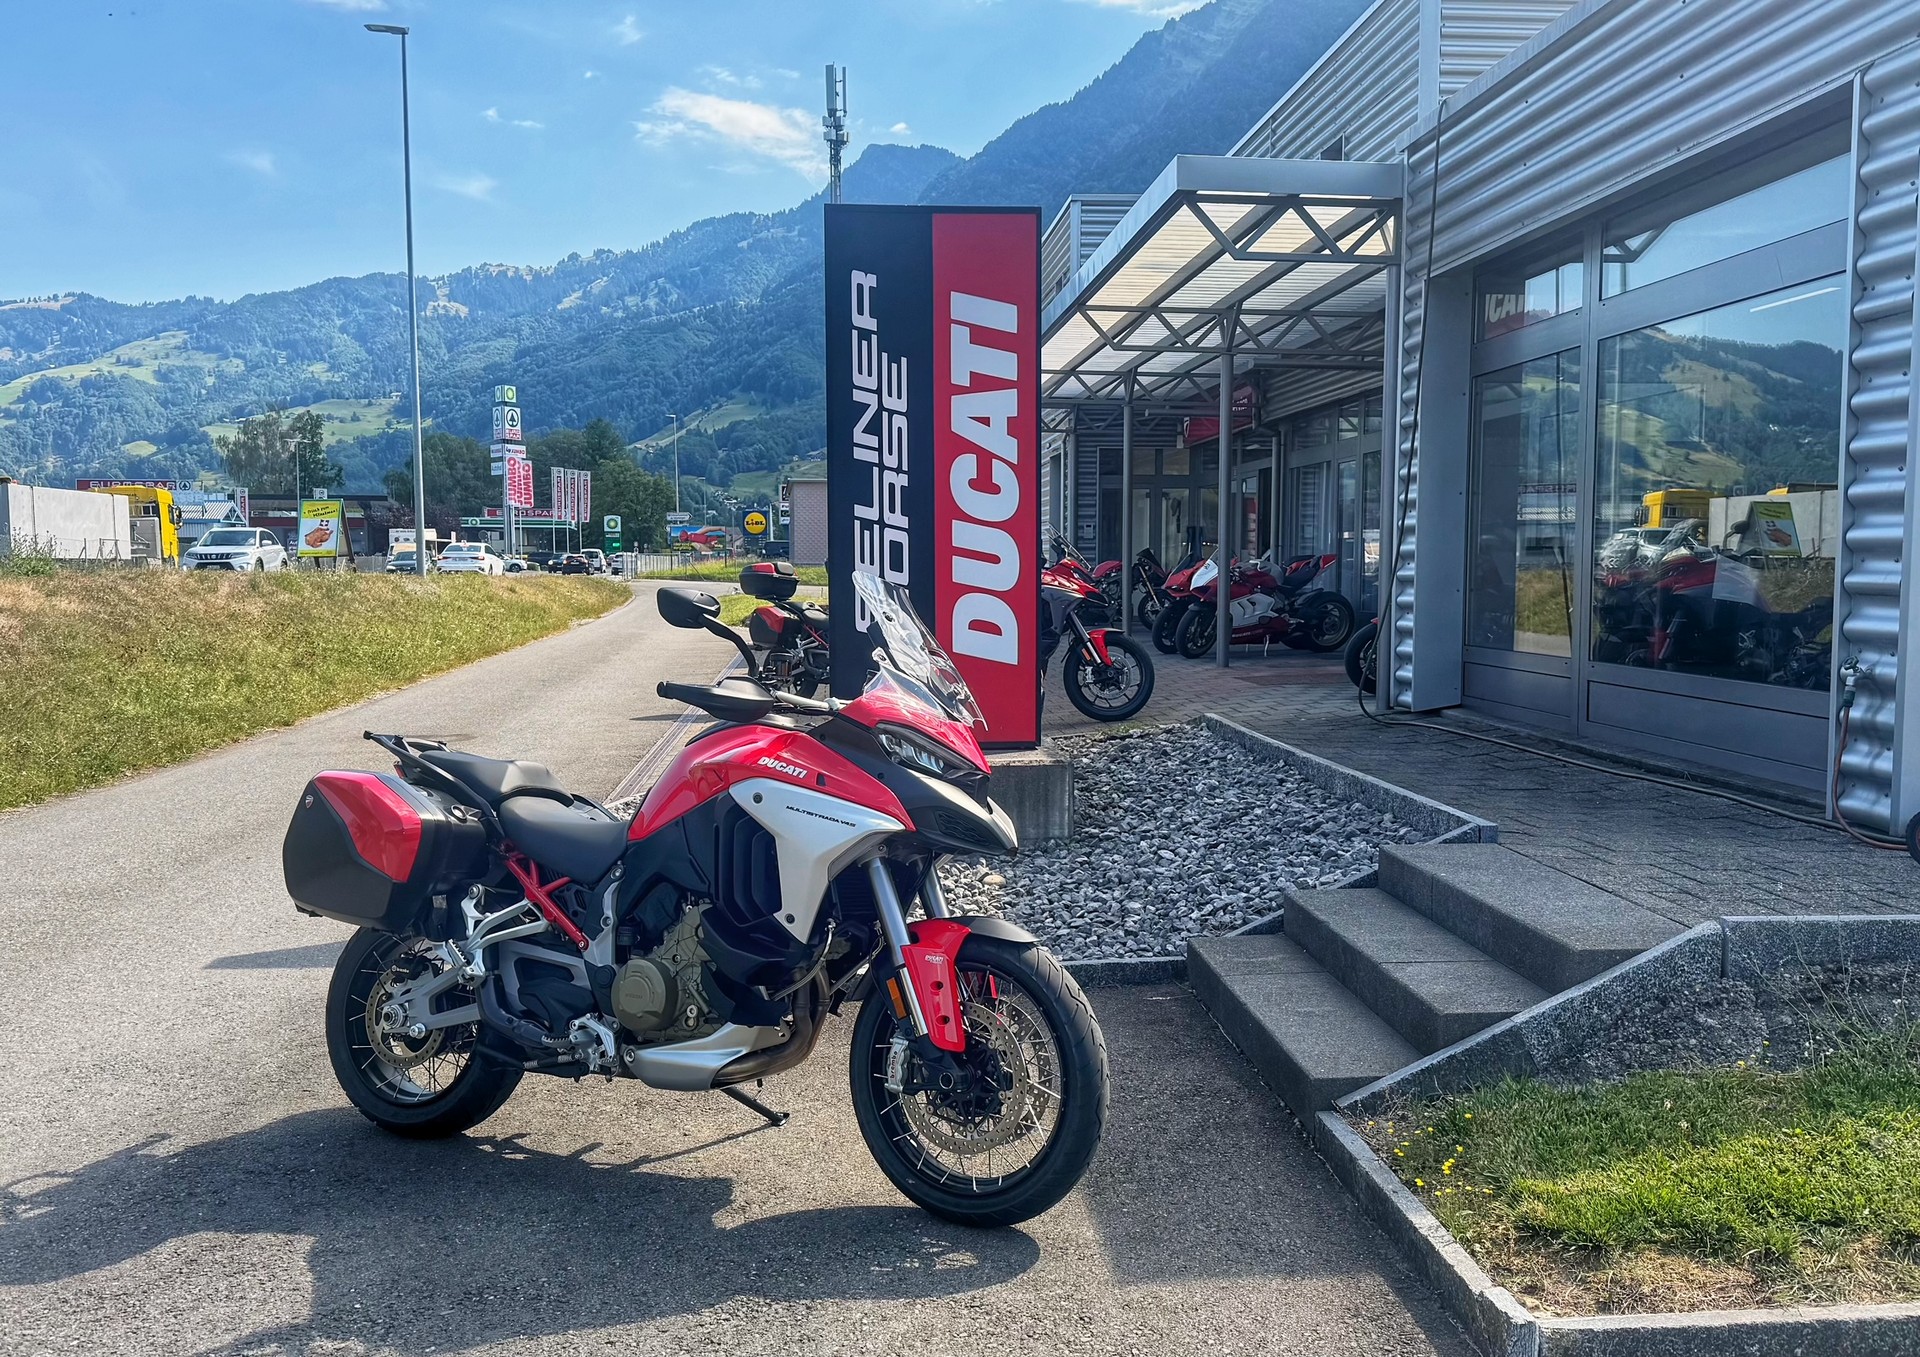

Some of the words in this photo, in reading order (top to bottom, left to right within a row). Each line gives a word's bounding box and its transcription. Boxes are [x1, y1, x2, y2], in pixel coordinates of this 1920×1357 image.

[507, 457, 517, 504] JUMBO
[522, 463, 533, 507] JUMBO
[881, 352, 910, 608] ORSE
[950, 291, 1020, 666] DUCATI
[757, 756, 808, 778] DUCATI
[786, 805, 840, 823] MULTISTRADA
[890, 1051, 898, 1079] brembo
